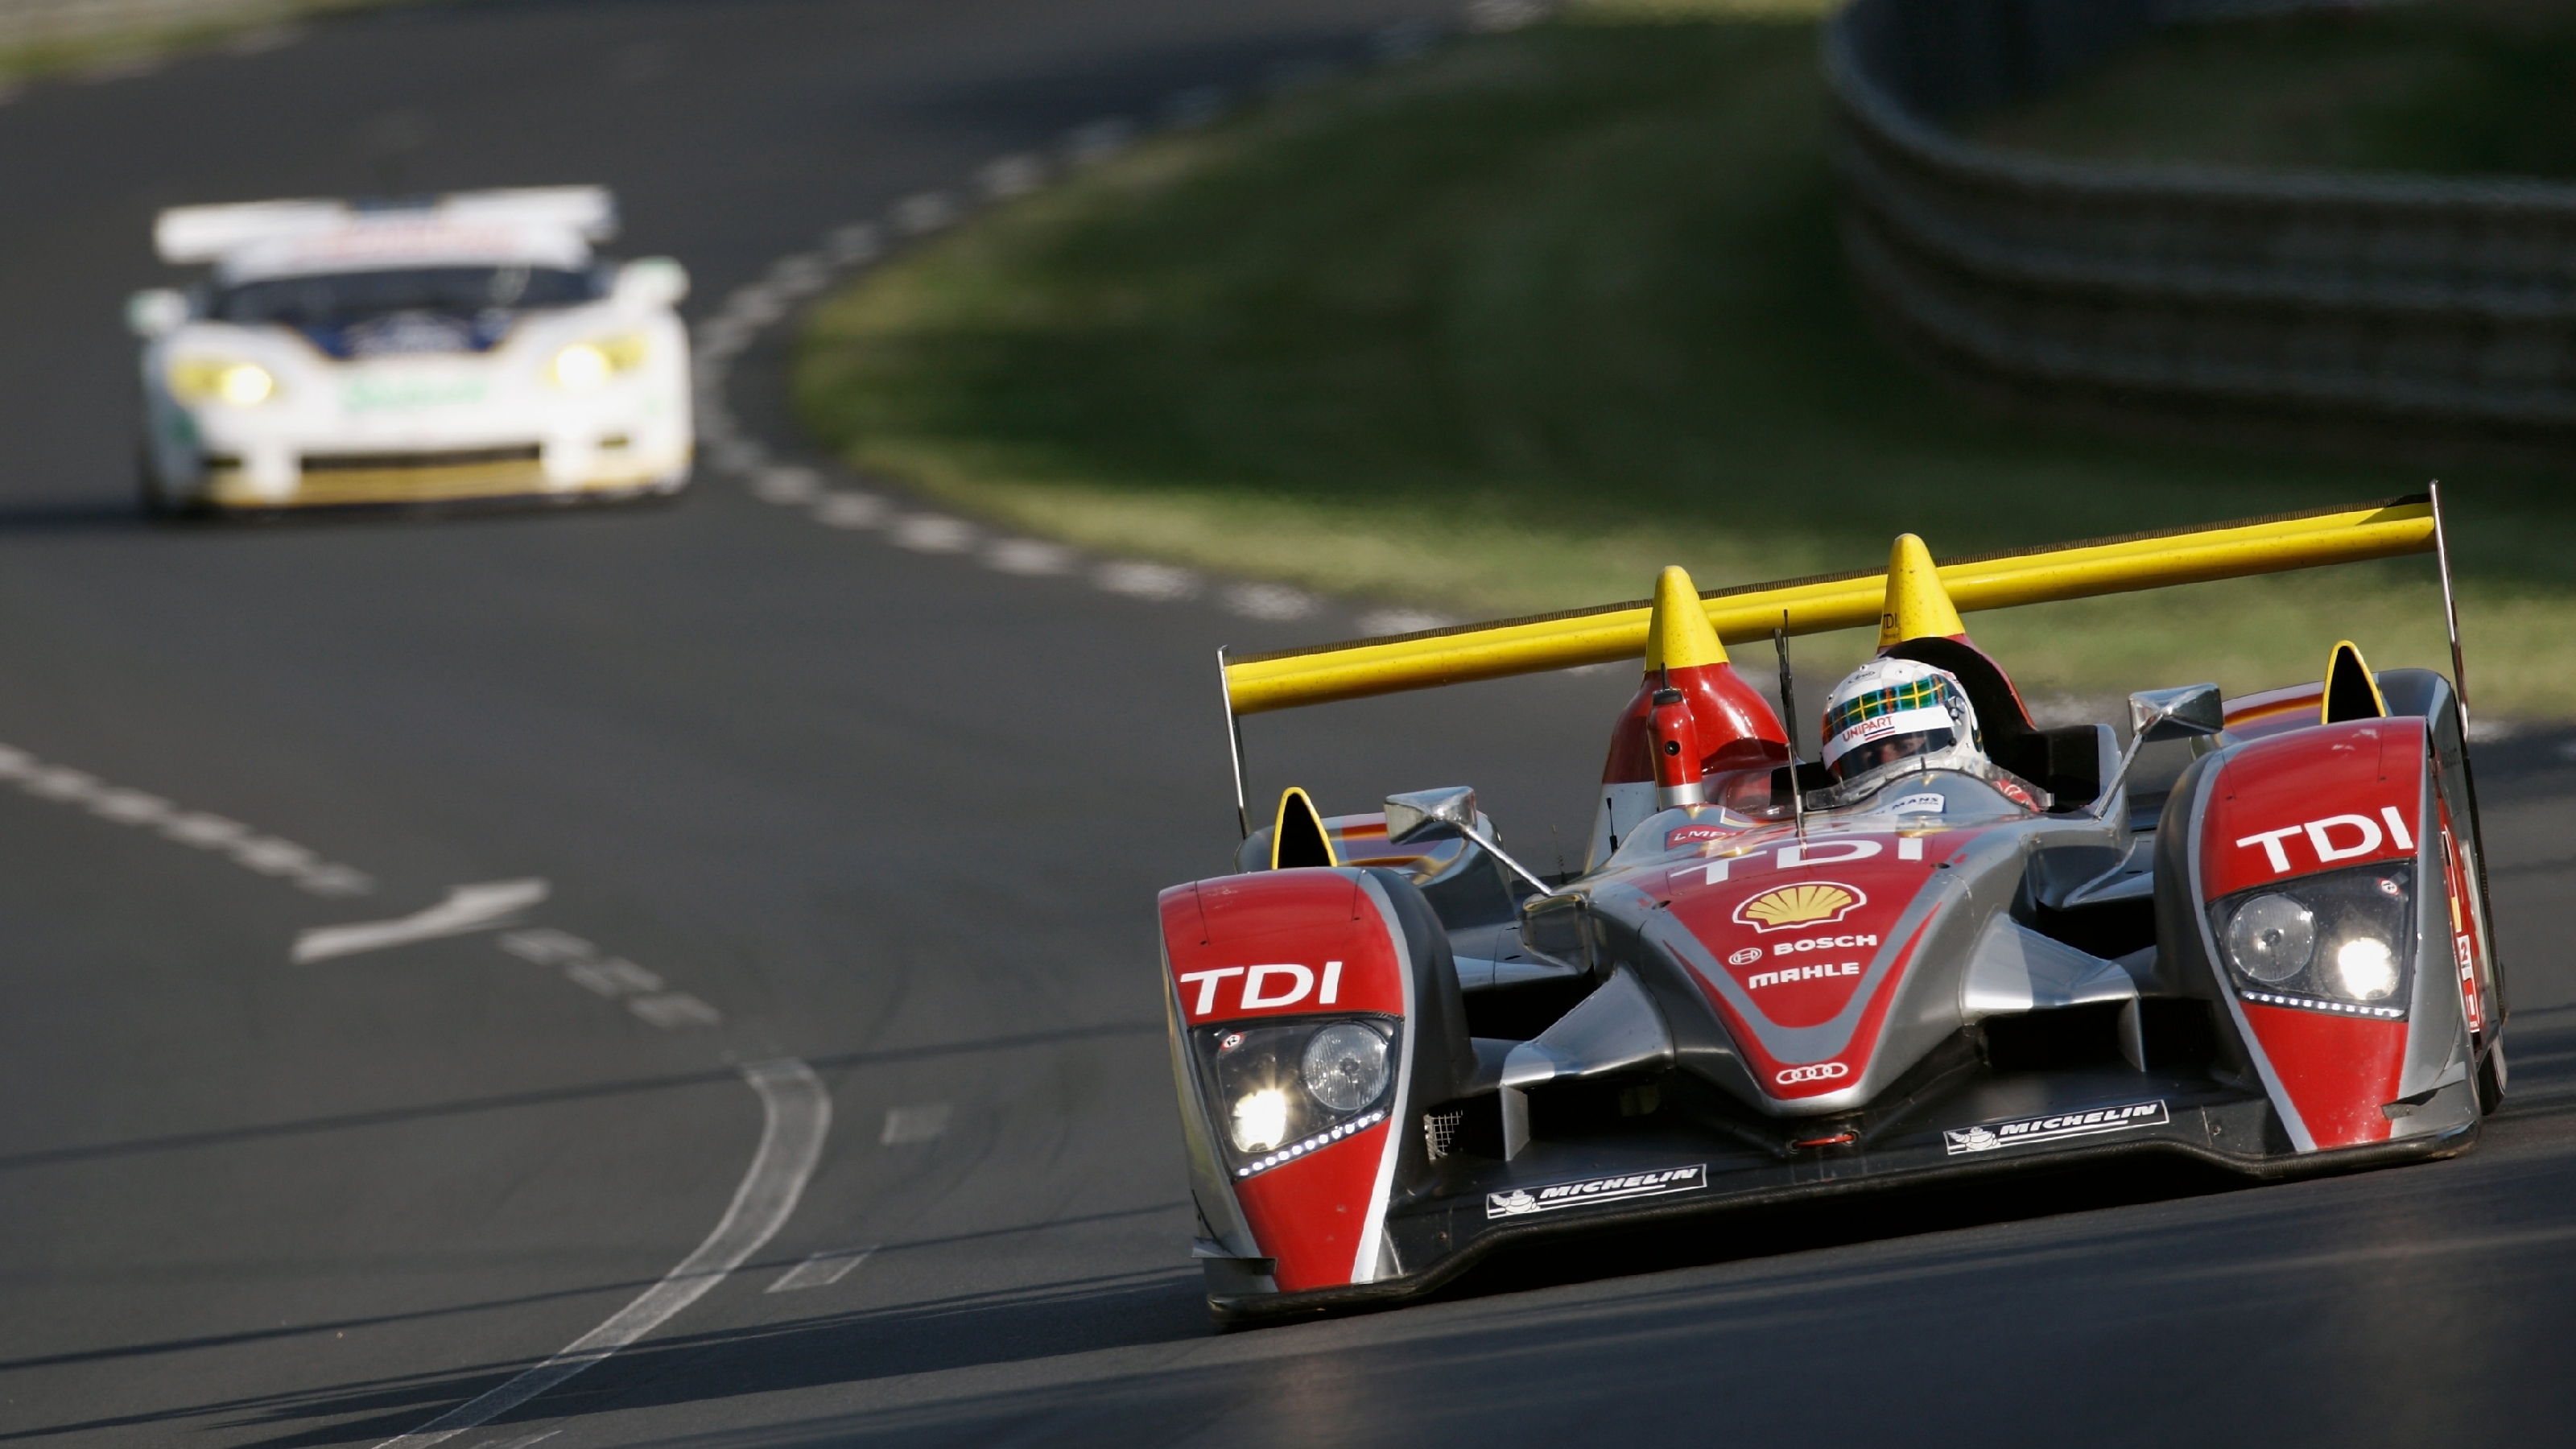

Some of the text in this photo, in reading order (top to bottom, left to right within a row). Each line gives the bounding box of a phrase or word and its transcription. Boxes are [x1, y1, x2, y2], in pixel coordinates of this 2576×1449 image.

[1841, 716, 1893, 742] UNIPART
[2235, 806, 2413, 873] TDI
[1670, 838, 1923, 886] TDI
[1773, 935, 1878, 956] BOSCH
[1180, 961, 1343, 1015] TDI
[1748, 962, 1860, 989] MAHLE
[2000, 1104, 2157, 1136] MICHELIN
[1539, 1168, 1699, 1199] MICHELIN
